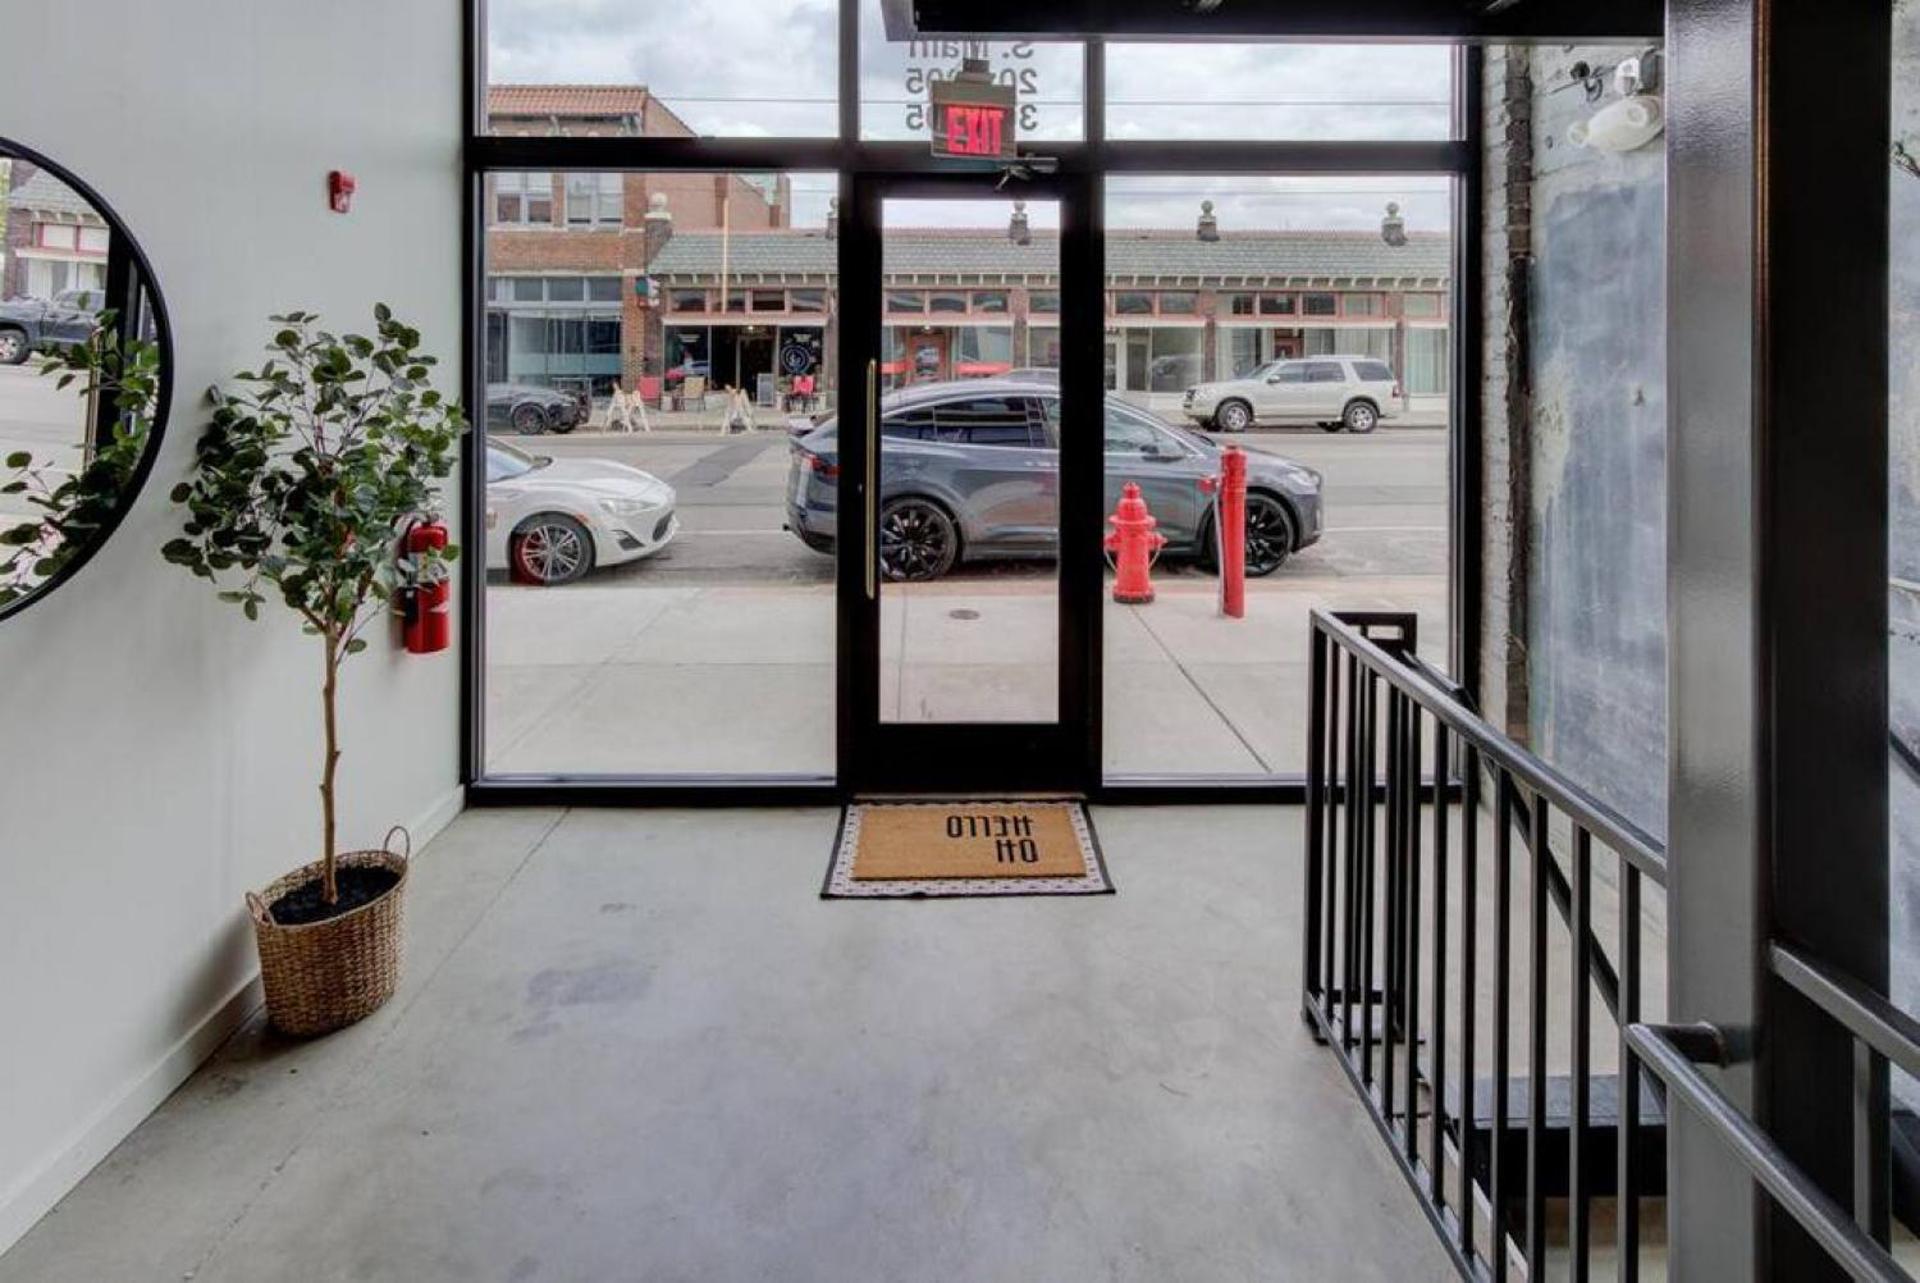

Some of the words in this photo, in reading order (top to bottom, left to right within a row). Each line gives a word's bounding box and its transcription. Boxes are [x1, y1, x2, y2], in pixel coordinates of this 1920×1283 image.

[947, 106, 1005, 154] EXIT
[946, 816, 1034, 838] HELLO
[995, 839, 1038, 863] OH
